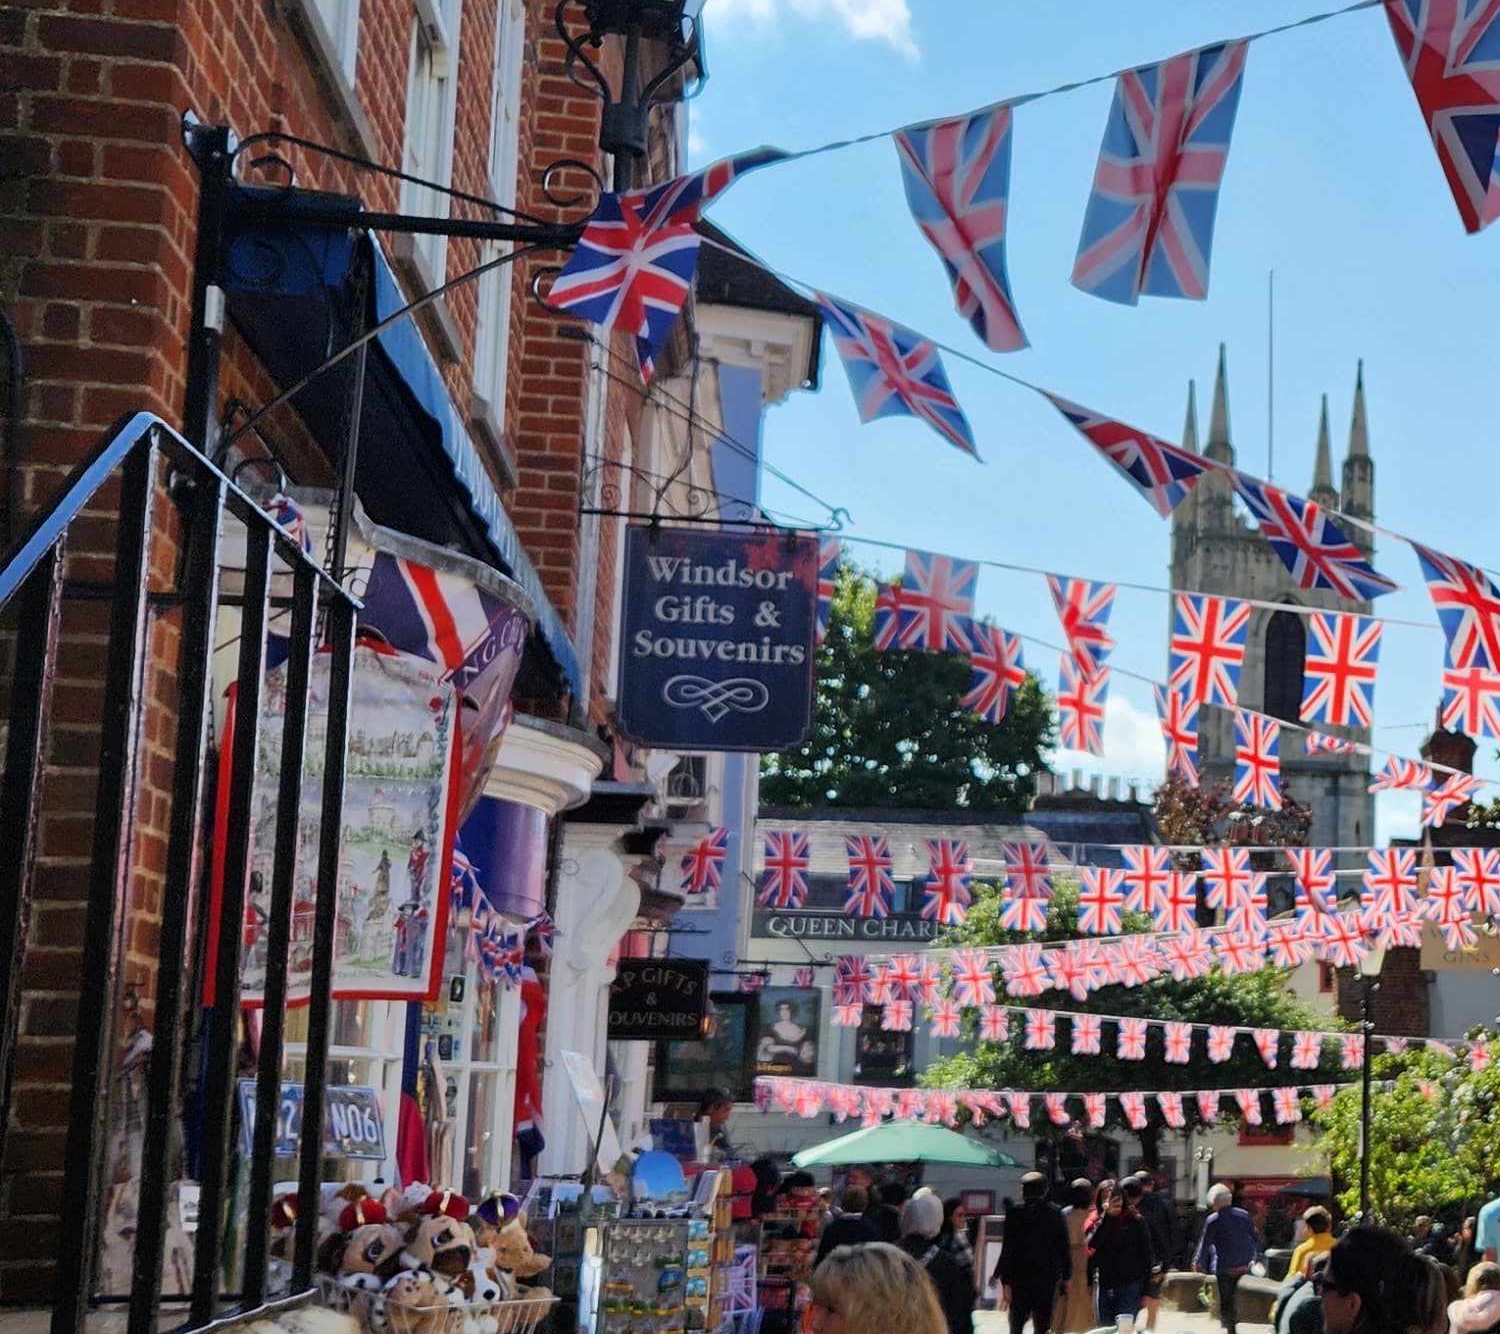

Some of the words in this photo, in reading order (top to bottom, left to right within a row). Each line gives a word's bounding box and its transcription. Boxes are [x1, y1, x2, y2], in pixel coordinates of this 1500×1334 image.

[647, 555, 794, 591] Windsor
[654, 595, 736, 625] Gifts
[754, 600, 782, 628] &
[633, 629, 806, 665] Souvenirs
[768, 916, 856, 939] QUEEN
[863, 918, 942, 939] CHARL
[641, 967, 698, 996] GIFTS
[645, 991, 658, 1006] &
[608, 1010, 699, 1027] OUVENIRS
